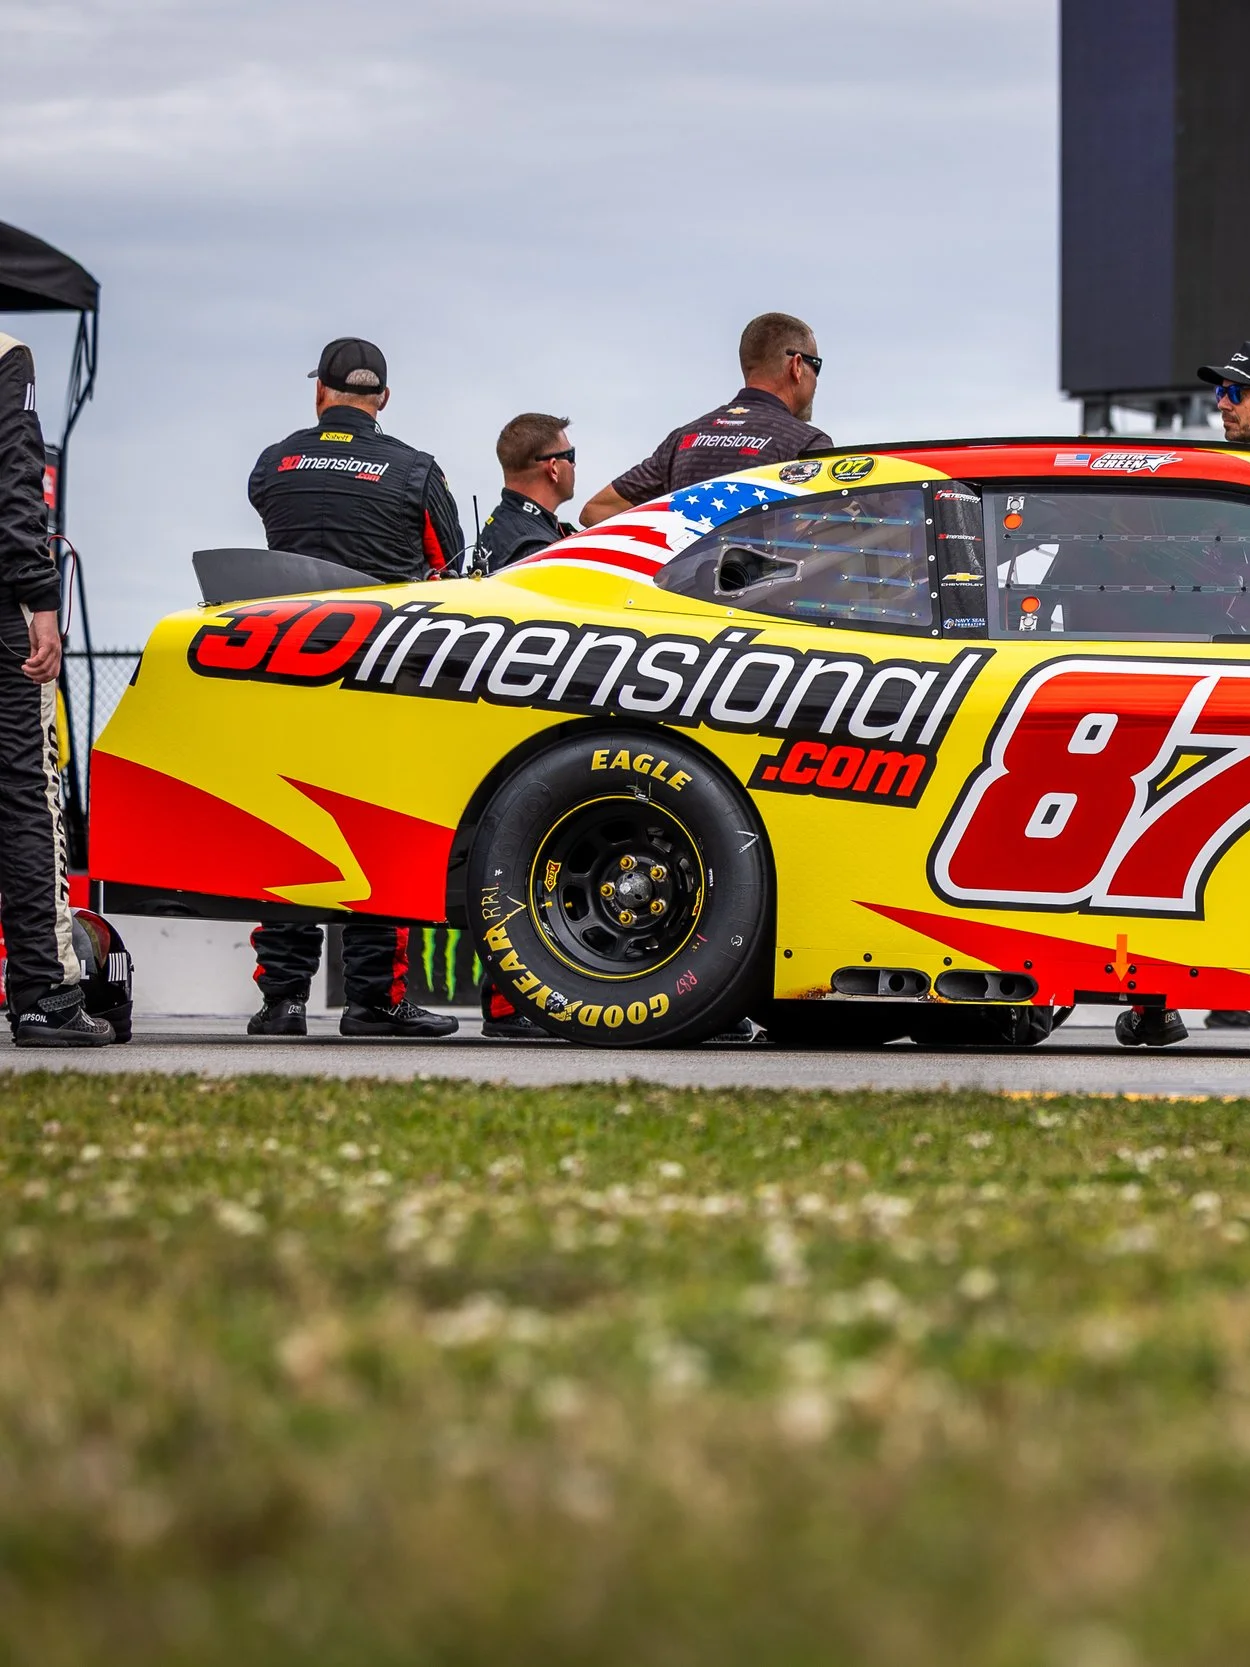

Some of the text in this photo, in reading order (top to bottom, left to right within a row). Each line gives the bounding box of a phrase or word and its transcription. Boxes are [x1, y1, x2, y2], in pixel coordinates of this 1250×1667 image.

[277, 454, 390, 476] 3Dimensional
[834, 460, 872, 475] 07
[1093, 460, 1145, 469] GREEN
[1102, 453, 1145, 461] AUSTIN
[522, 501, 541, 515] 87
[194, 602, 980, 746] 3Dimensional
[591, 749, 693, 792] EAGLE
[760, 740, 928, 798] .com
[547, 866, 556, 887] AERO
